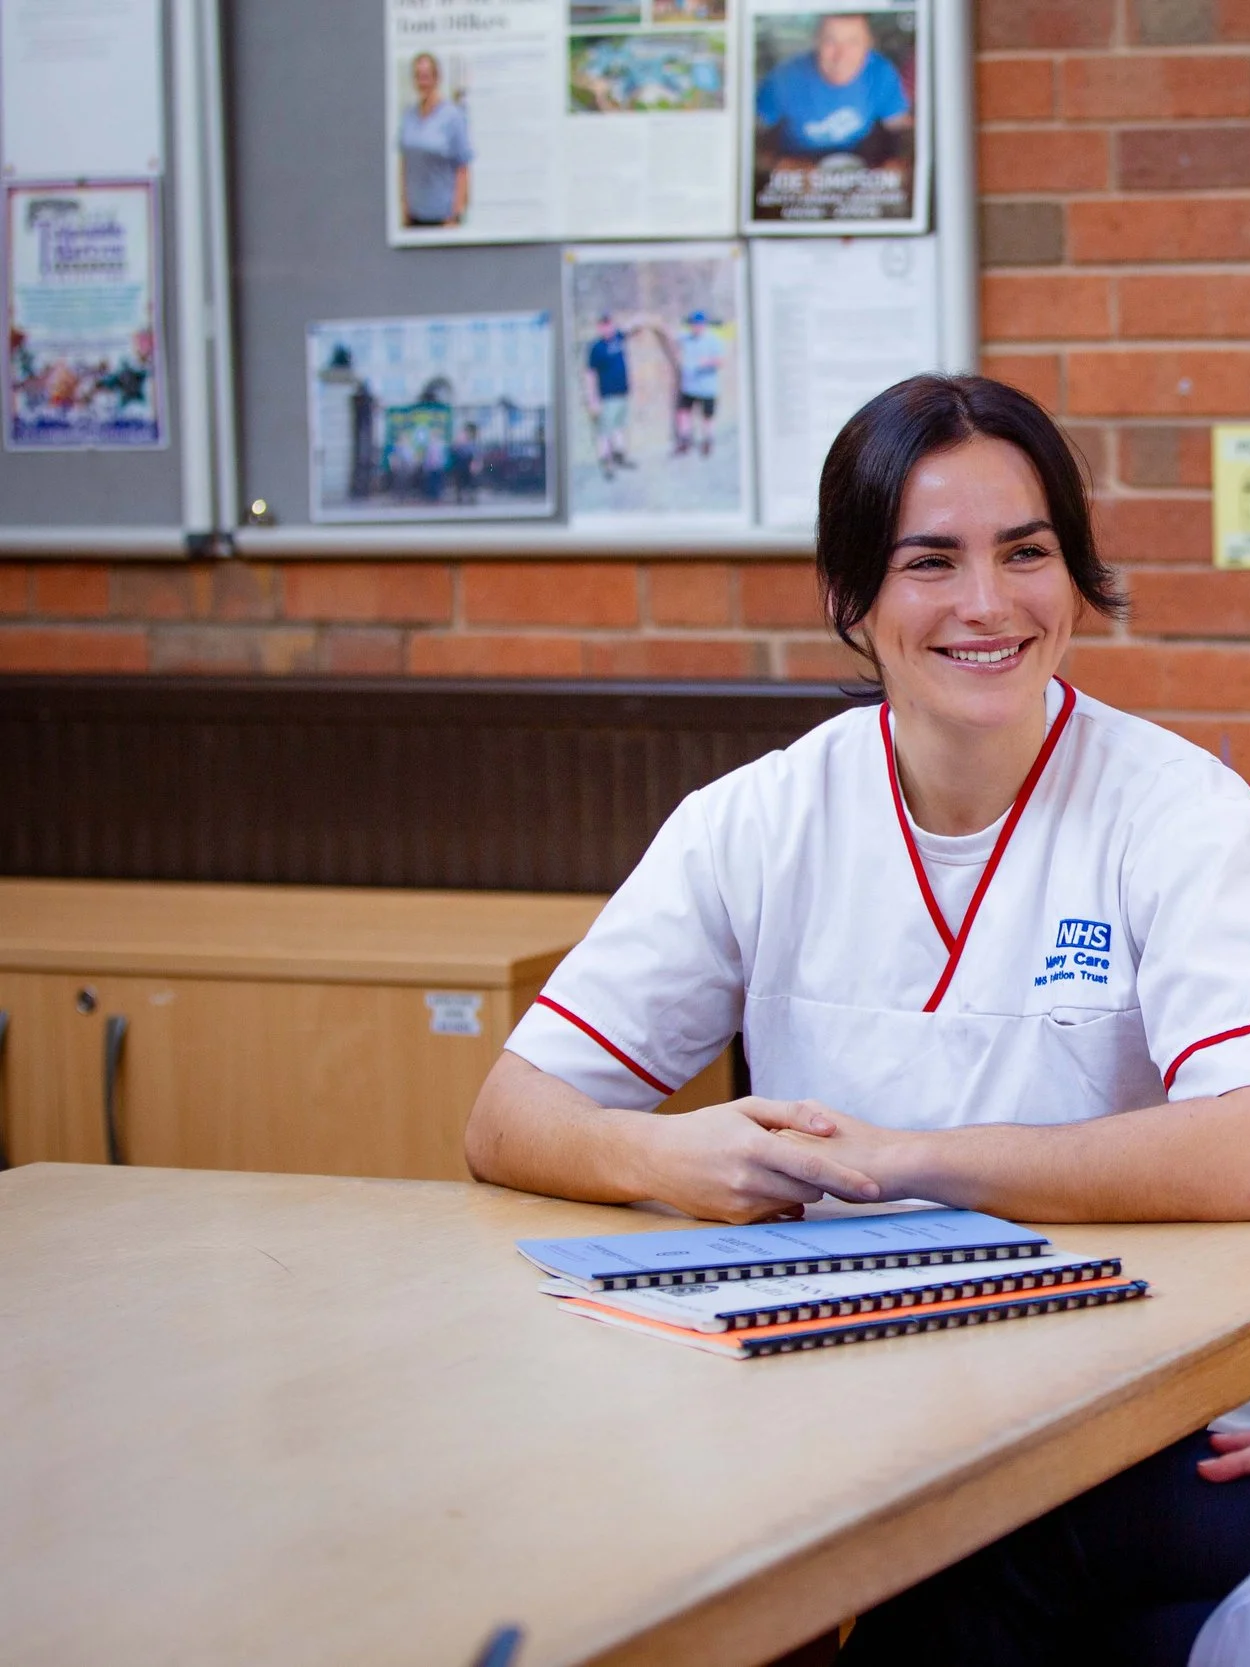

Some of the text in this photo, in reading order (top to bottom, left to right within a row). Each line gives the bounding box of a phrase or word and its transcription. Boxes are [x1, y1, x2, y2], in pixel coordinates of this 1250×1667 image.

[1058, 922, 1108, 948] NHS
[1074, 952, 1110, 969] Care
[1080, 970, 1108, 984] Trust
